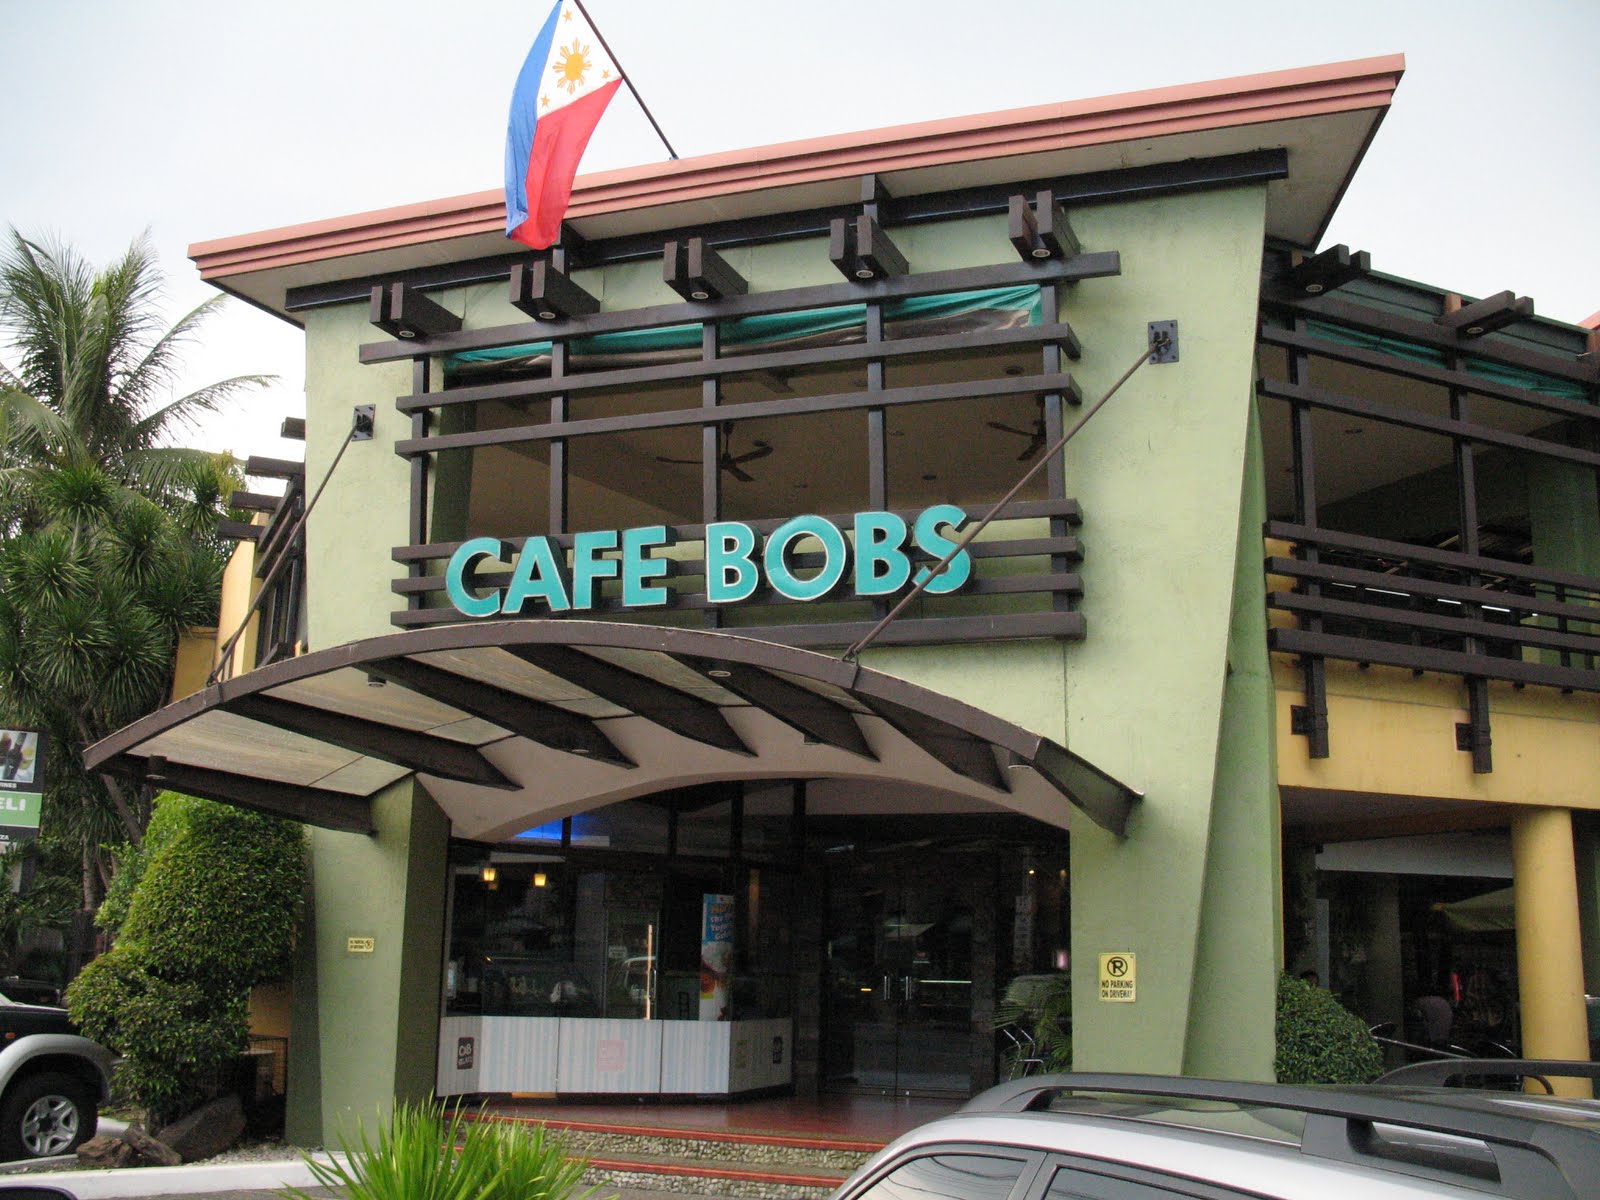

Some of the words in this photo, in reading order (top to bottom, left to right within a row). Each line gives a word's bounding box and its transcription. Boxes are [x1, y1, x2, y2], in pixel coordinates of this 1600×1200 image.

[445, 524, 669, 617] CAFE
[706, 504, 973, 602] BOBS
[1102, 980, 1109, 988] NO
